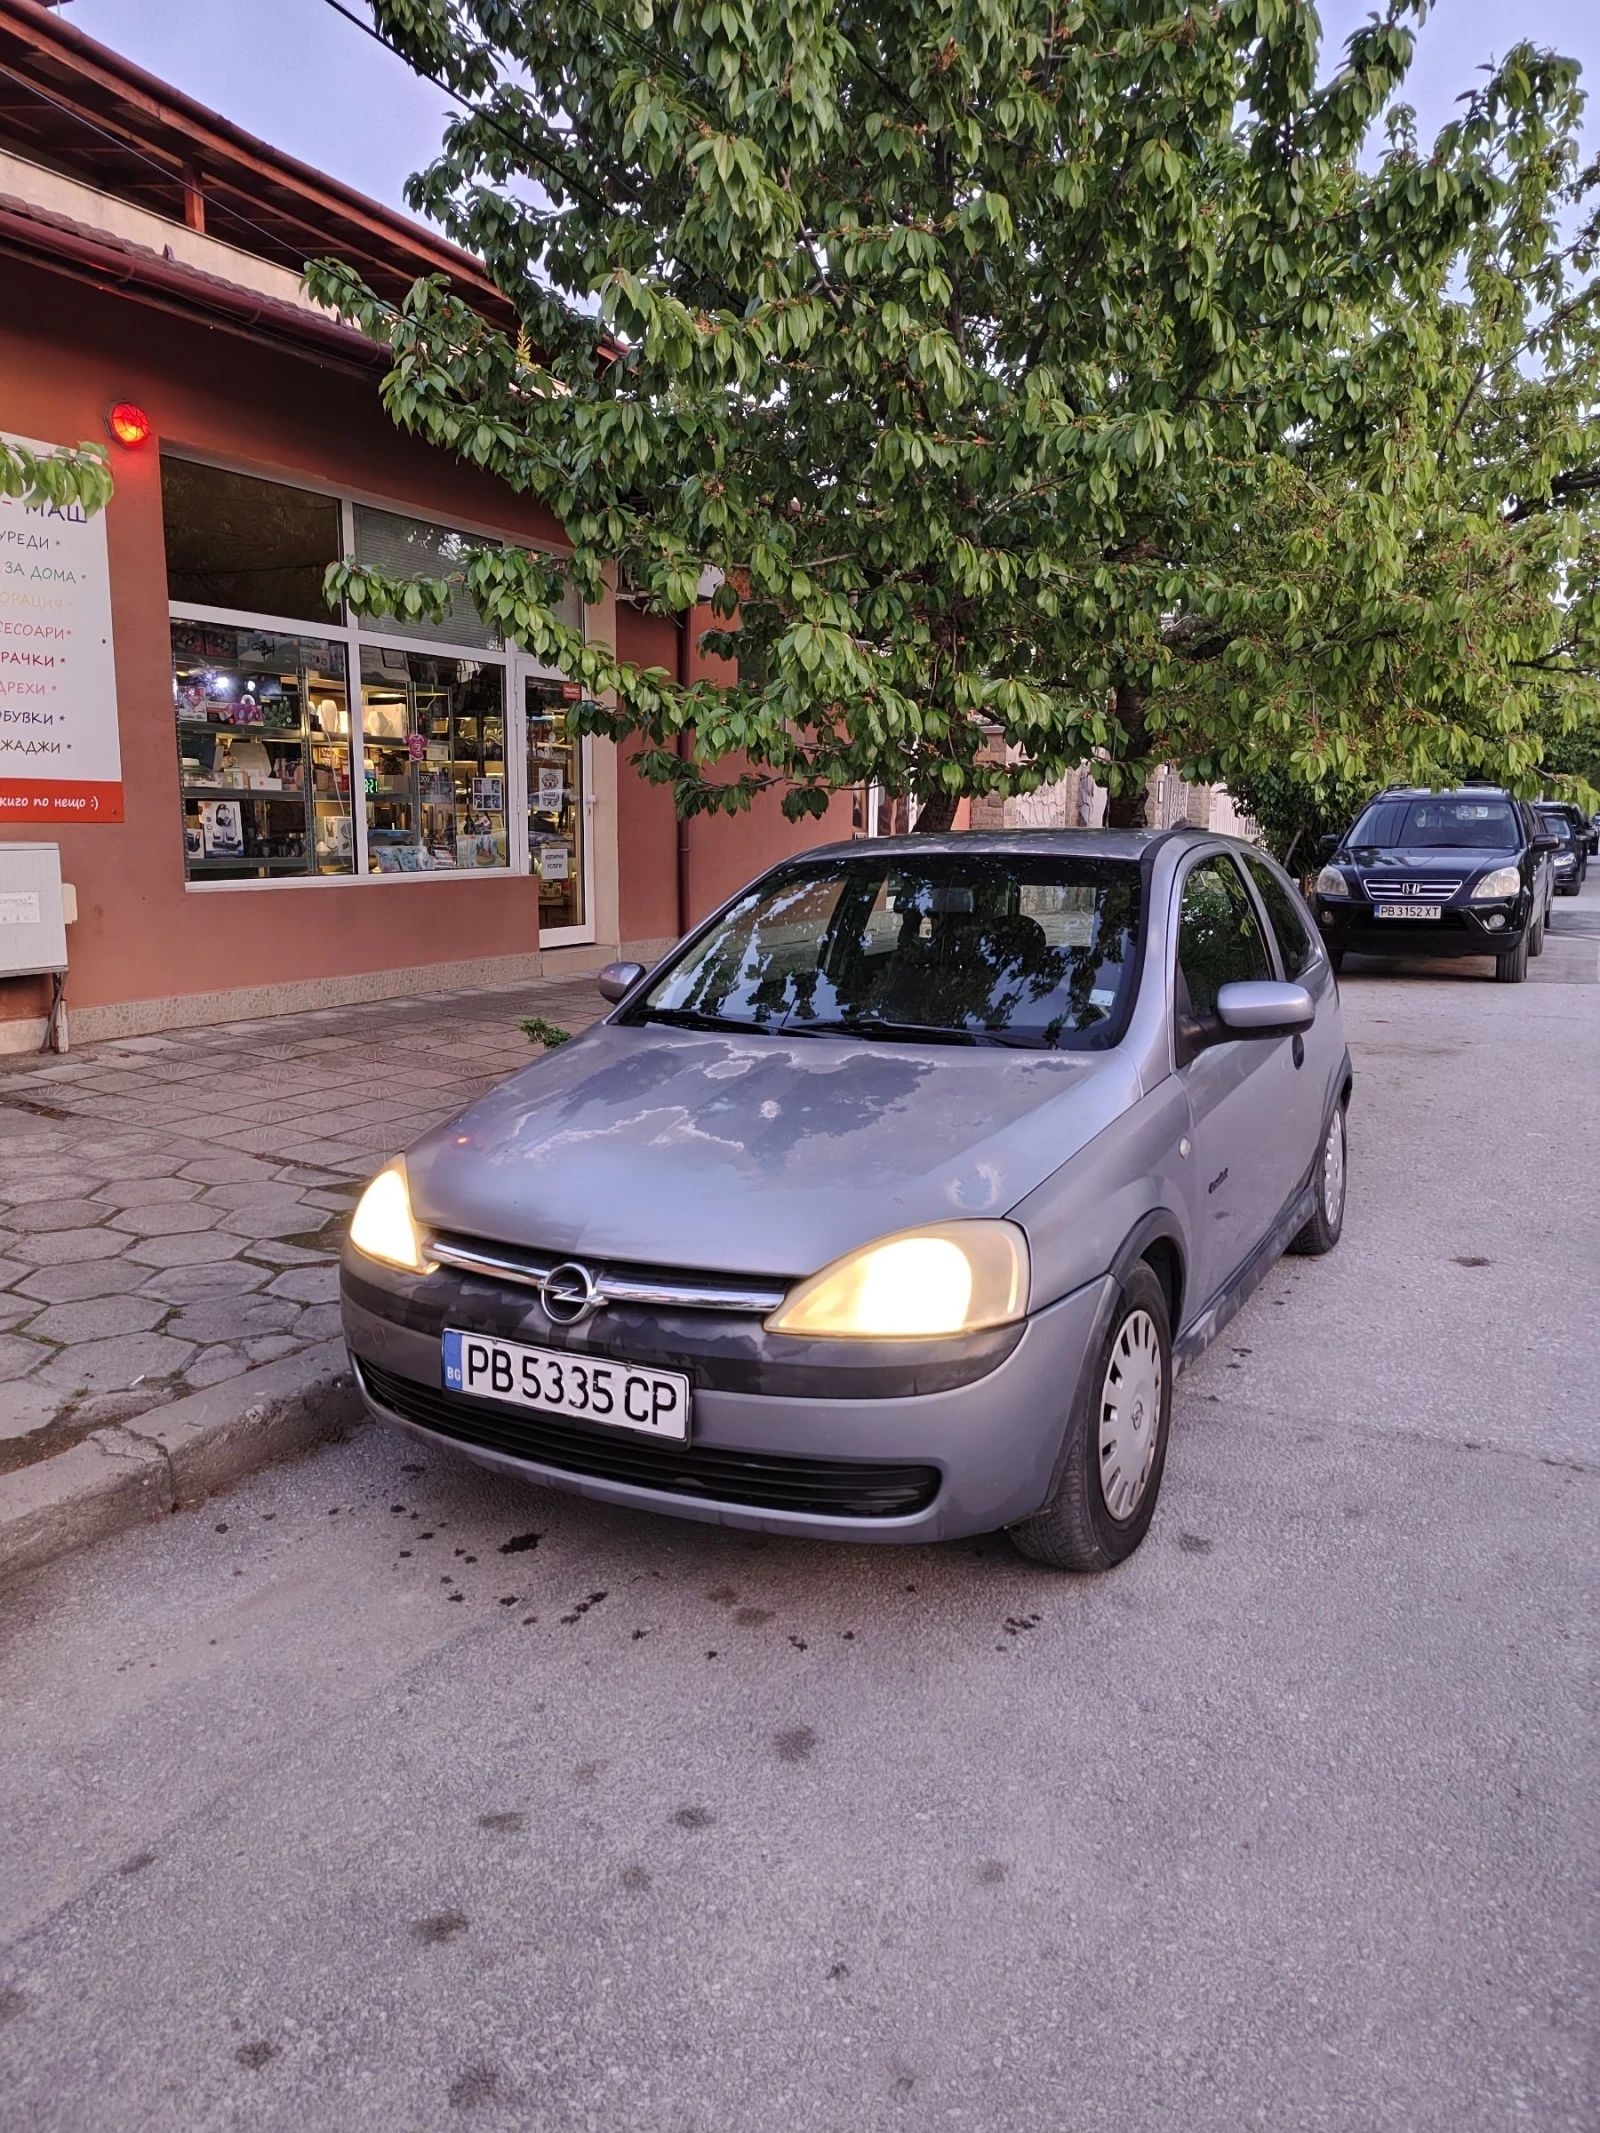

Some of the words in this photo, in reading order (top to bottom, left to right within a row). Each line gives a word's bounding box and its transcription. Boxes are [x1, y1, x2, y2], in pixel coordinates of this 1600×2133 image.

[5, 561, 26, 577] ЗА
[30, 565, 77, 584] ДОМА
[33, 797, 49, 808] по
[54, 797, 86, 810] нещо
[1380, 906, 1395, 917] PB
[1396, 906, 1423, 917] 3152
[1425, 906, 1439, 917] XT
[447, 1366, 461, 1382] BG
[468, 1343, 514, 1393] PB
[522, 1355, 614, 1414] 5335
[624, 1376, 677, 1425] CP
